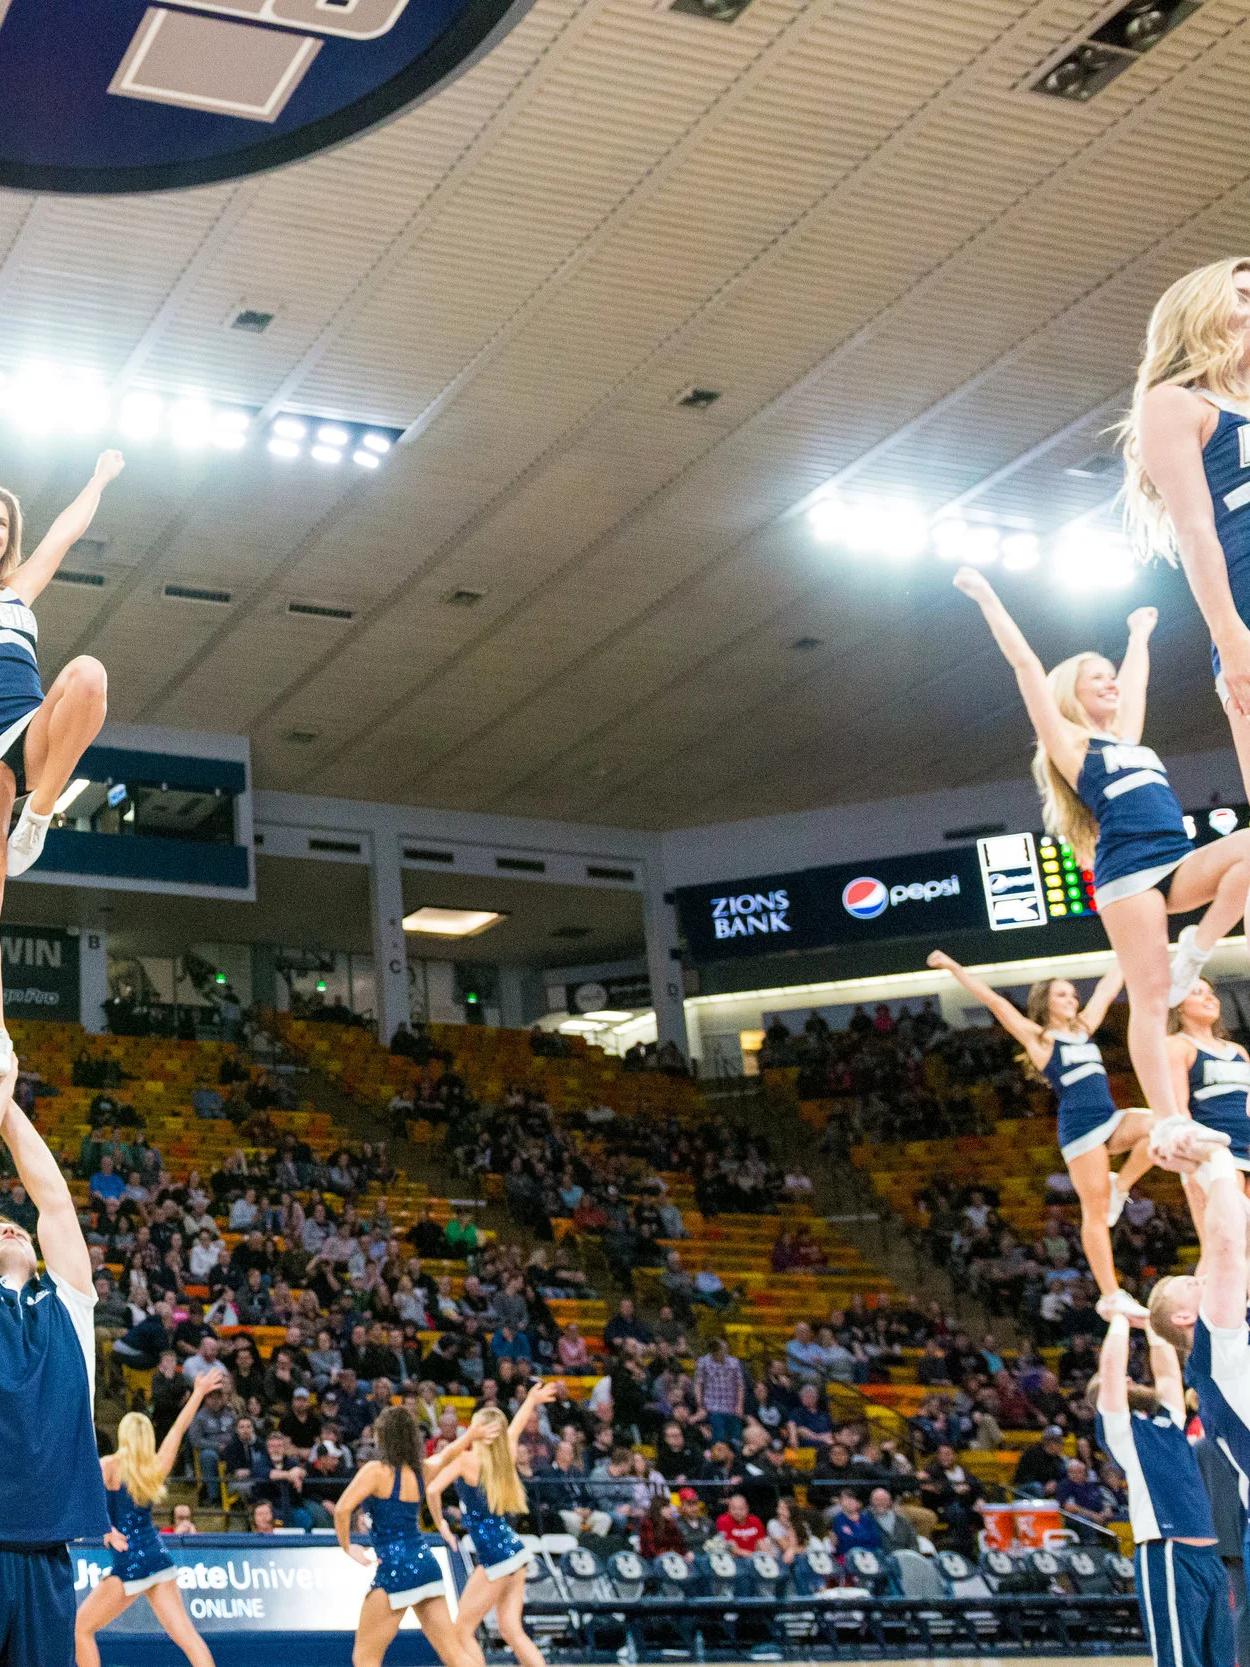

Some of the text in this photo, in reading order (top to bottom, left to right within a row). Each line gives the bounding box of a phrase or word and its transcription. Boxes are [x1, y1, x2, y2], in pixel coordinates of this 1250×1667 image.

[890, 874, 961, 907] pepsi
[710, 889, 790, 919] ZIONS
[713, 910, 792, 940] BANK
[88, 934, 99, 950] B
[390, 959, 402, 974] C
[189, 1598, 266, 1619] ONLINE
